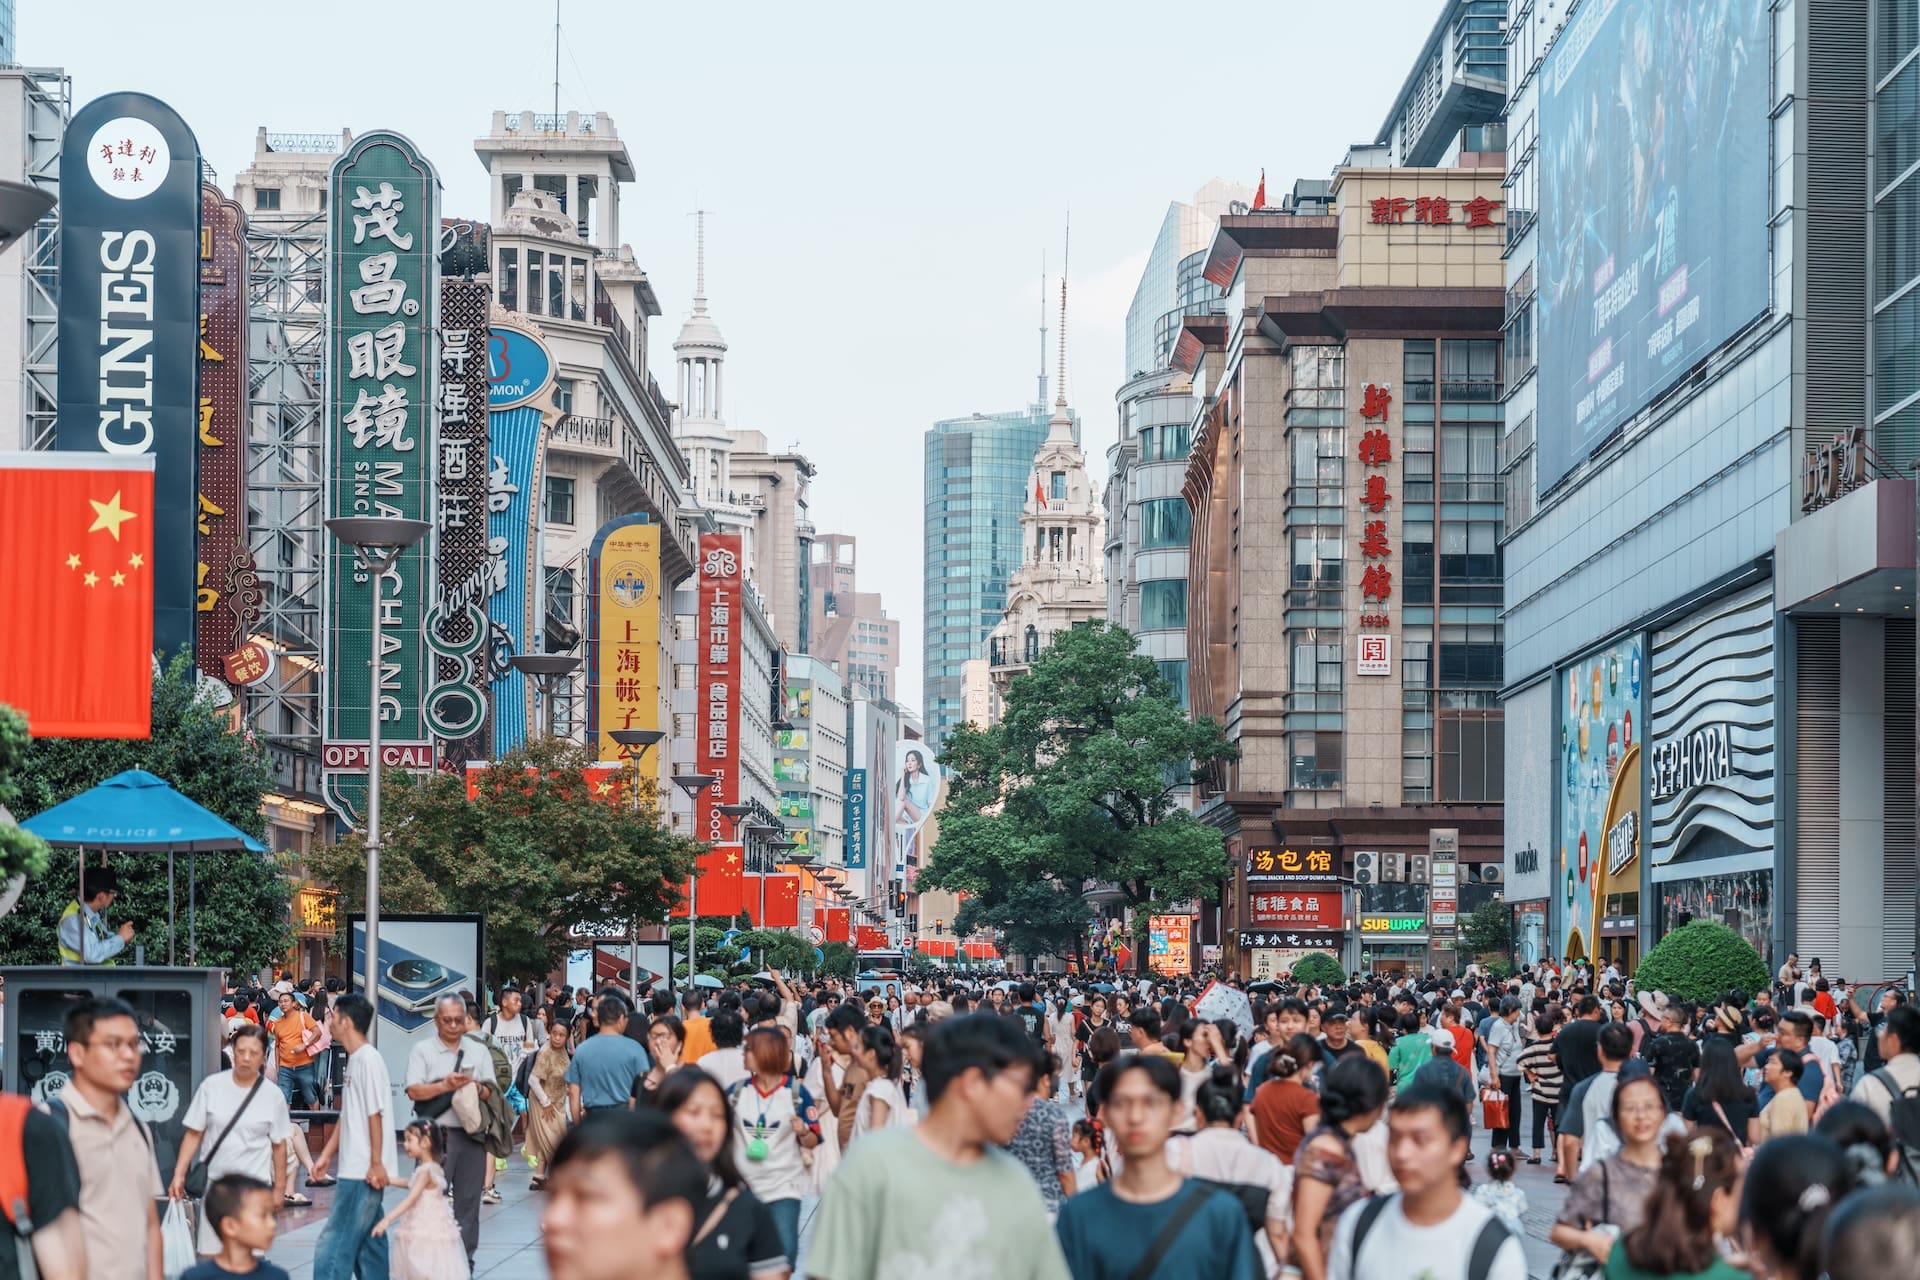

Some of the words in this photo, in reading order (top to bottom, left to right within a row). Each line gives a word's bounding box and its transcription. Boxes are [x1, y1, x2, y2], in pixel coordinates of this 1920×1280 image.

[343, 182, 413, 452] 茂昌眼镜
[1359, 615, 1390, 629] 1926
[708, 588, 730, 759] 上海市第一食品商店
[325, 747, 430, 767] OPTCAL
[1650, 723, 1730, 798] SEPHORA
[87, 827, 158, 837] POLICE
[1256, 850, 1332, 872] 汤包馆
[1256, 896, 1320, 912] 新雅食品
[1361, 918, 1425, 931] SUBWAY
